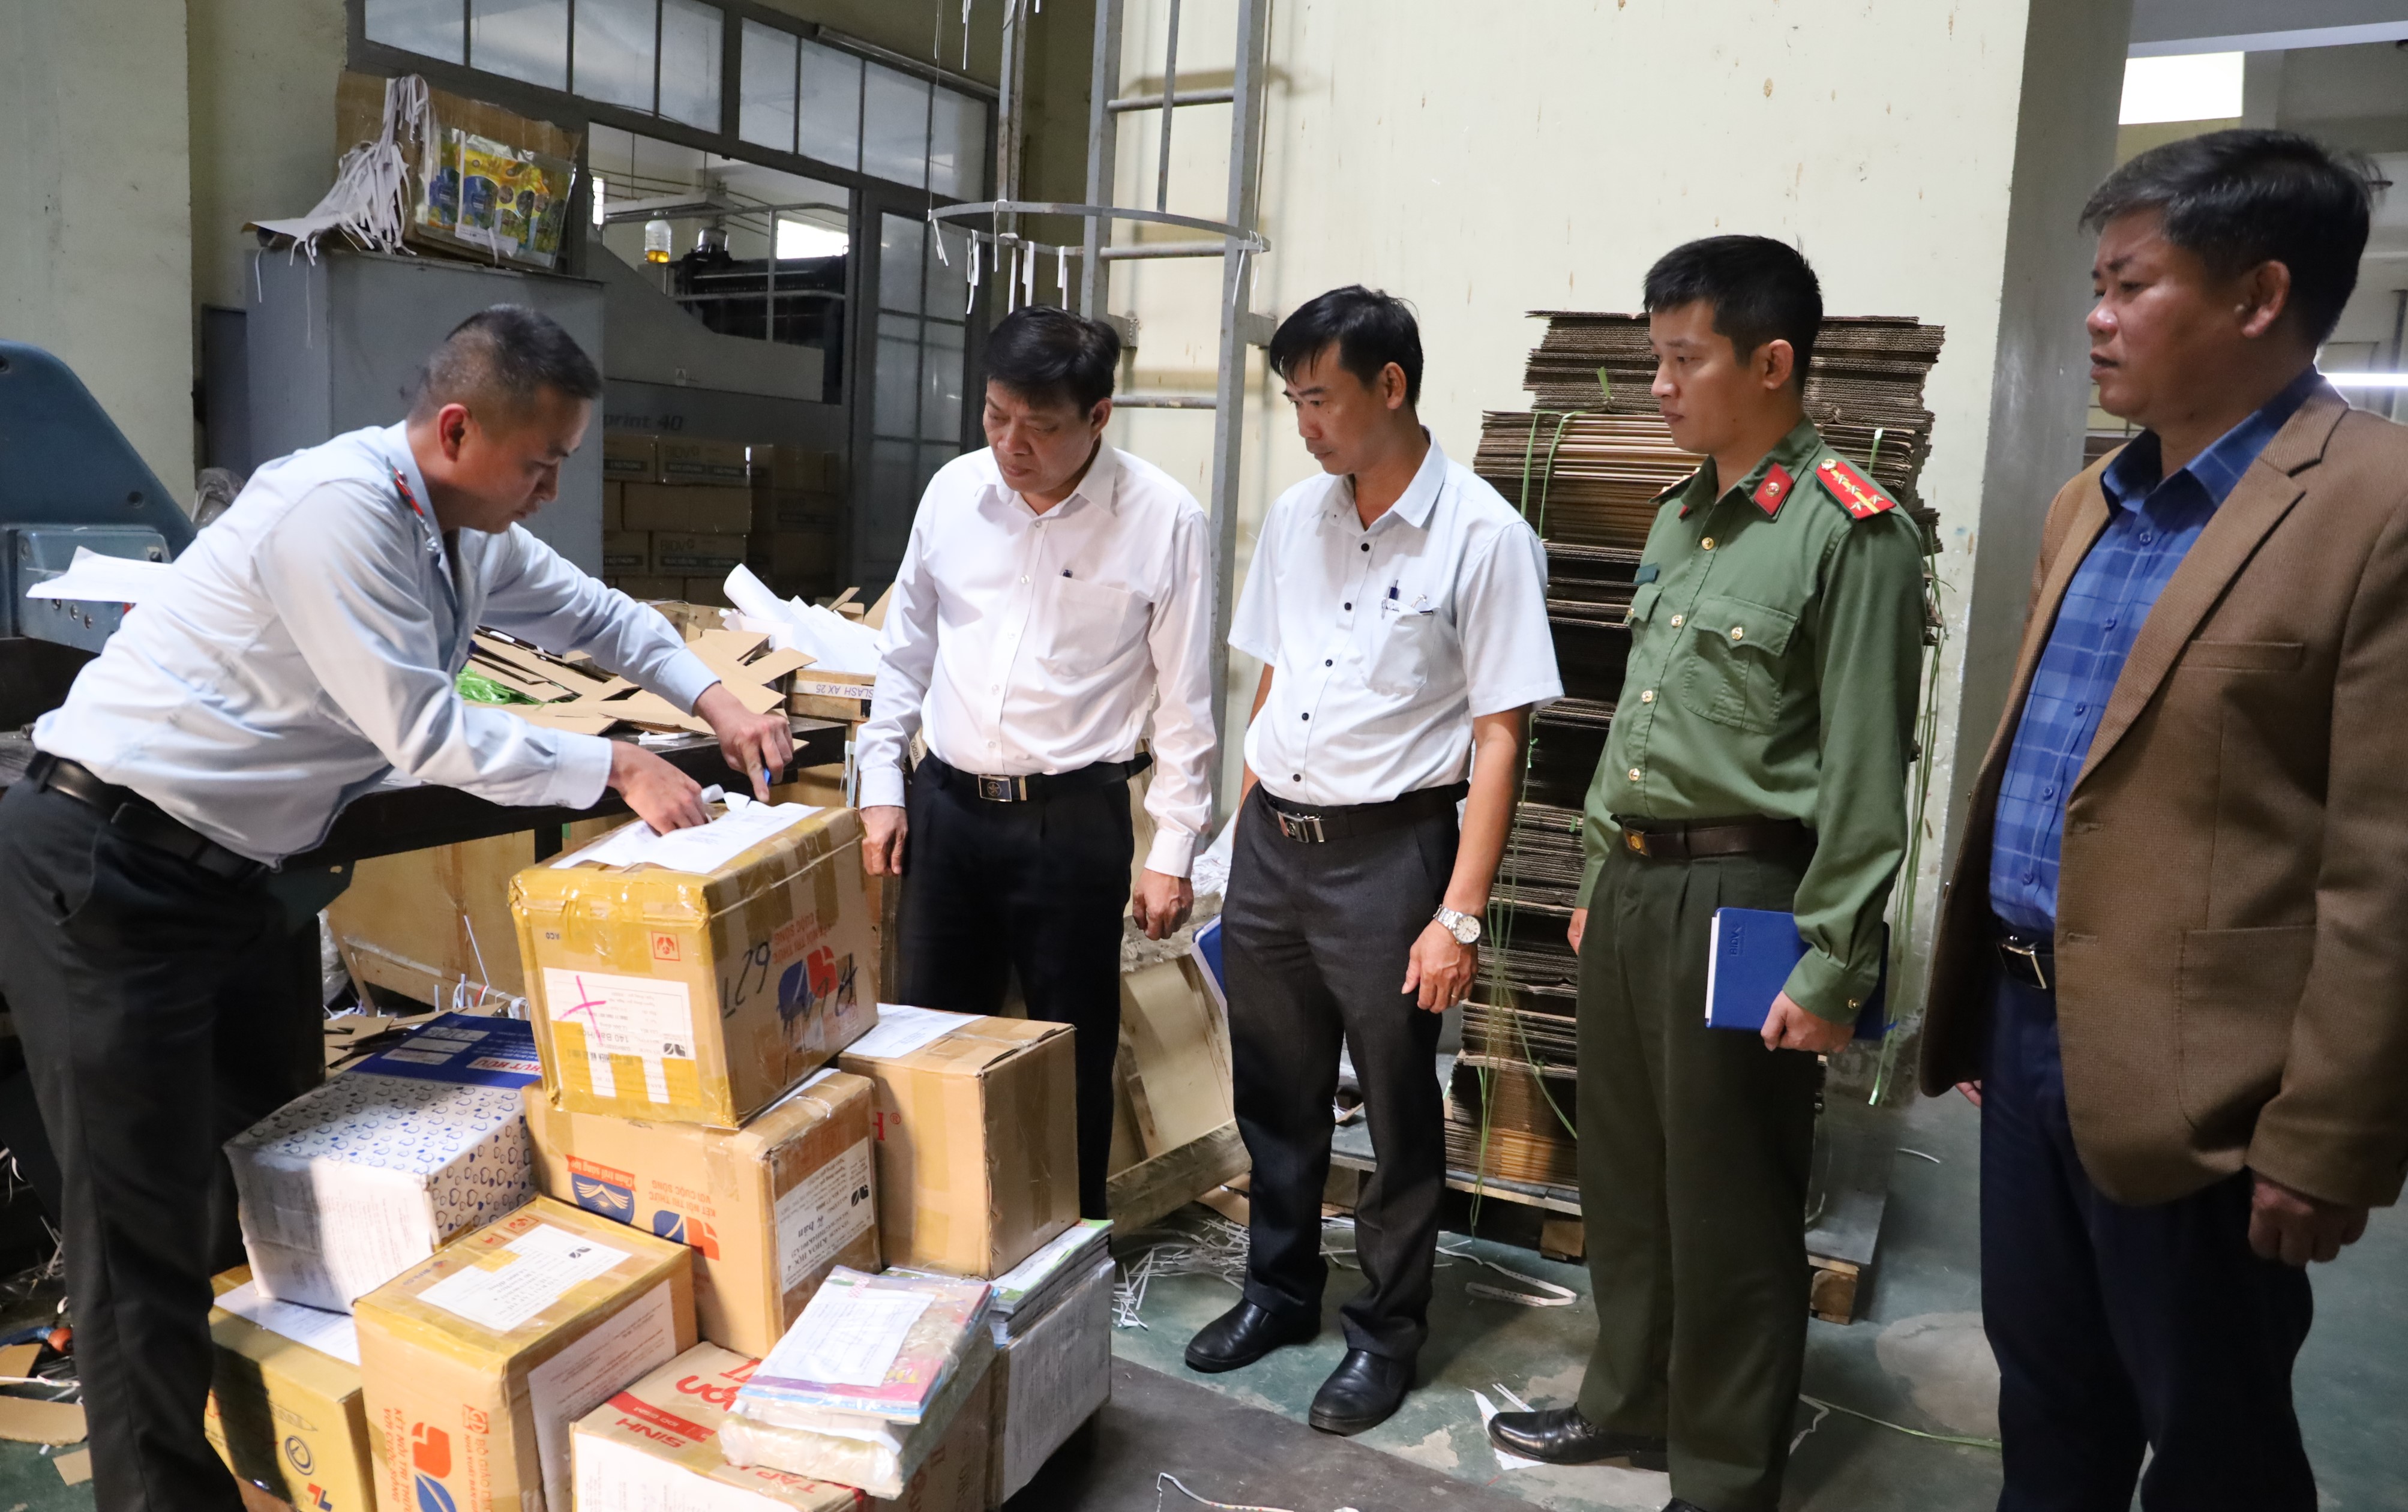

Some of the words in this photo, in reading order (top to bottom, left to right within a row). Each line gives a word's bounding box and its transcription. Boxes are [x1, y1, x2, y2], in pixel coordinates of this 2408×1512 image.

[816, 684, 826, 694] 25
[828, 685, 841, 694] AX
[614, 1034, 629, 1043] 140
[614, 1418, 685, 1448] SINH
